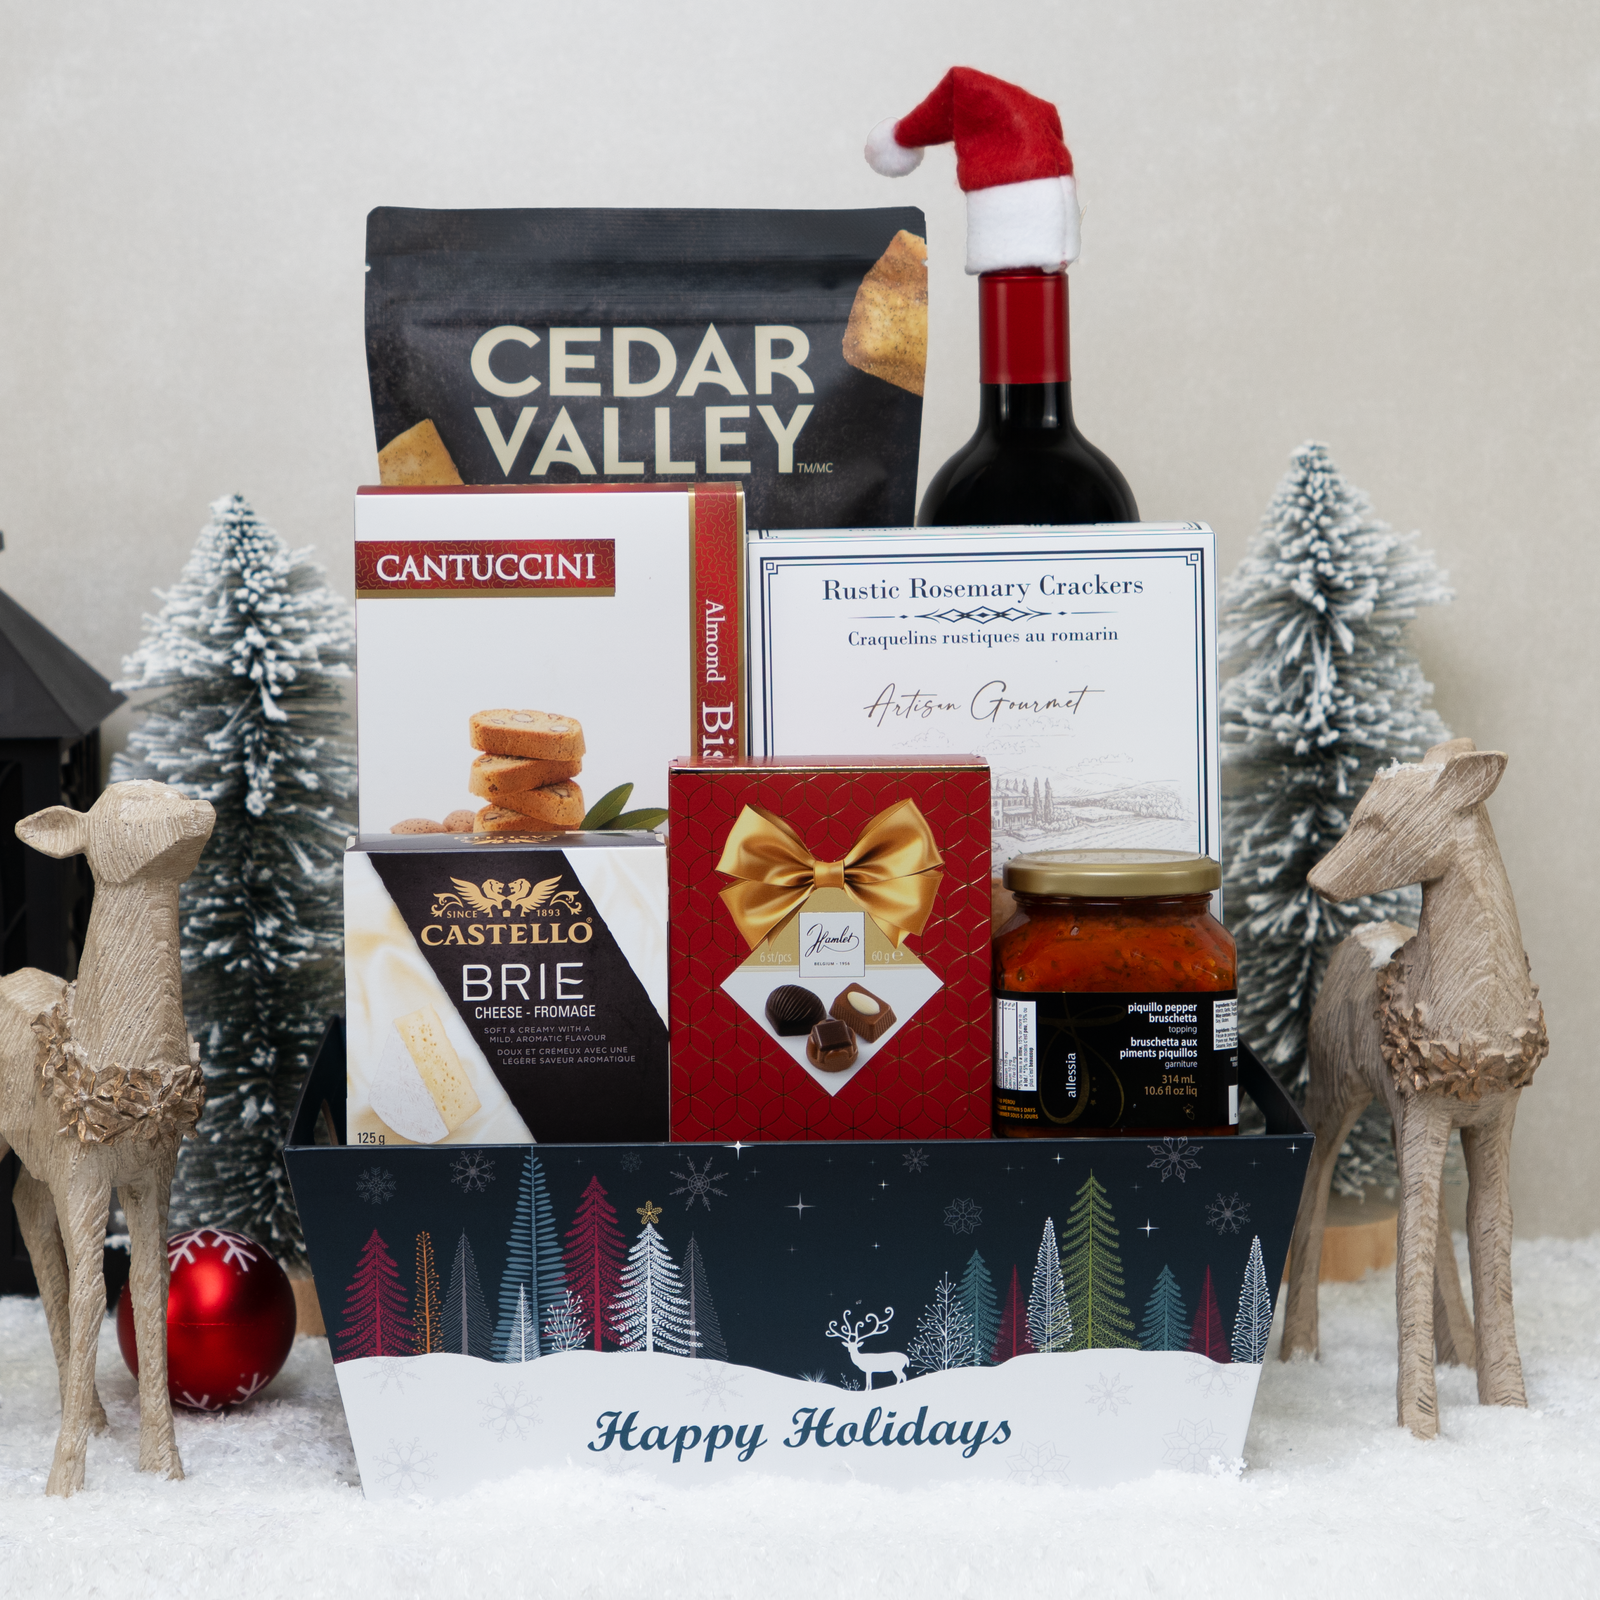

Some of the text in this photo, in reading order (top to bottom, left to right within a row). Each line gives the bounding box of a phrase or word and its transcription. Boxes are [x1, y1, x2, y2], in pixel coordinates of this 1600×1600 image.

[470, 322, 815, 398] CEDAR
[473, 403, 815, 478] VALLEY
[797, 462, 833, 474] TM/MC
[376, 552, 596, 582] CANTUCCINI
[822, 574, 1144, 603] Rustic Rosemary Crackers
[706, 599, 726, 683] Almond
[848, 627, 1118, 650] Craquelins rustiques au romarin
[863, 680, 1105, 727] Artisan Gourmet
[446, 910, 478, 918] SINCE
[536, 909, 560, 917] 1893
[420, 922, 593, 946] CASTELLO
[805, 923, 860, 958] Hamlet
[760, 951, 792, 965] 6 st/pcs
[872, 951, 882, 961] 60
[884, 953, 890, 963] g
[462, 962, 584, 1002] BRIE
[475, 1006, 523, 1019] CHEESE
[534, 1005, 596, 1018] FROMAGE
[1128, 1002, 1197, 1013] piquillo pepper
[1149, 1013, 1197, 1023] bruschetta
[1168, 1025, 1197, 1034] topping
[1130, 1037, 1179, 1047] bruschetta
[539, 1046, 581, 1055] CRÉMEUX
[1120, 1048, 1198, 1059] piments piquillos
[502, 1056, 536, 1065] LÉGÈRE
[577, 1055, 636, 1064] AROMATIQUE
[1165, 1060, 1198, 1069] garniture
[1066, 1052, 1076, 1097] allessia
[1162, 1075, 1195, 1084] 314 mL
[1144, 1086, 1162, 1096] 10.6
[1164, 1086, 1170, 1095] fl
[1185, 1086, 1198, 1097] liq
[357, 1132, 385, 1145] 125 g
[587, 1405, 1012, 1463] Happy Holidays
